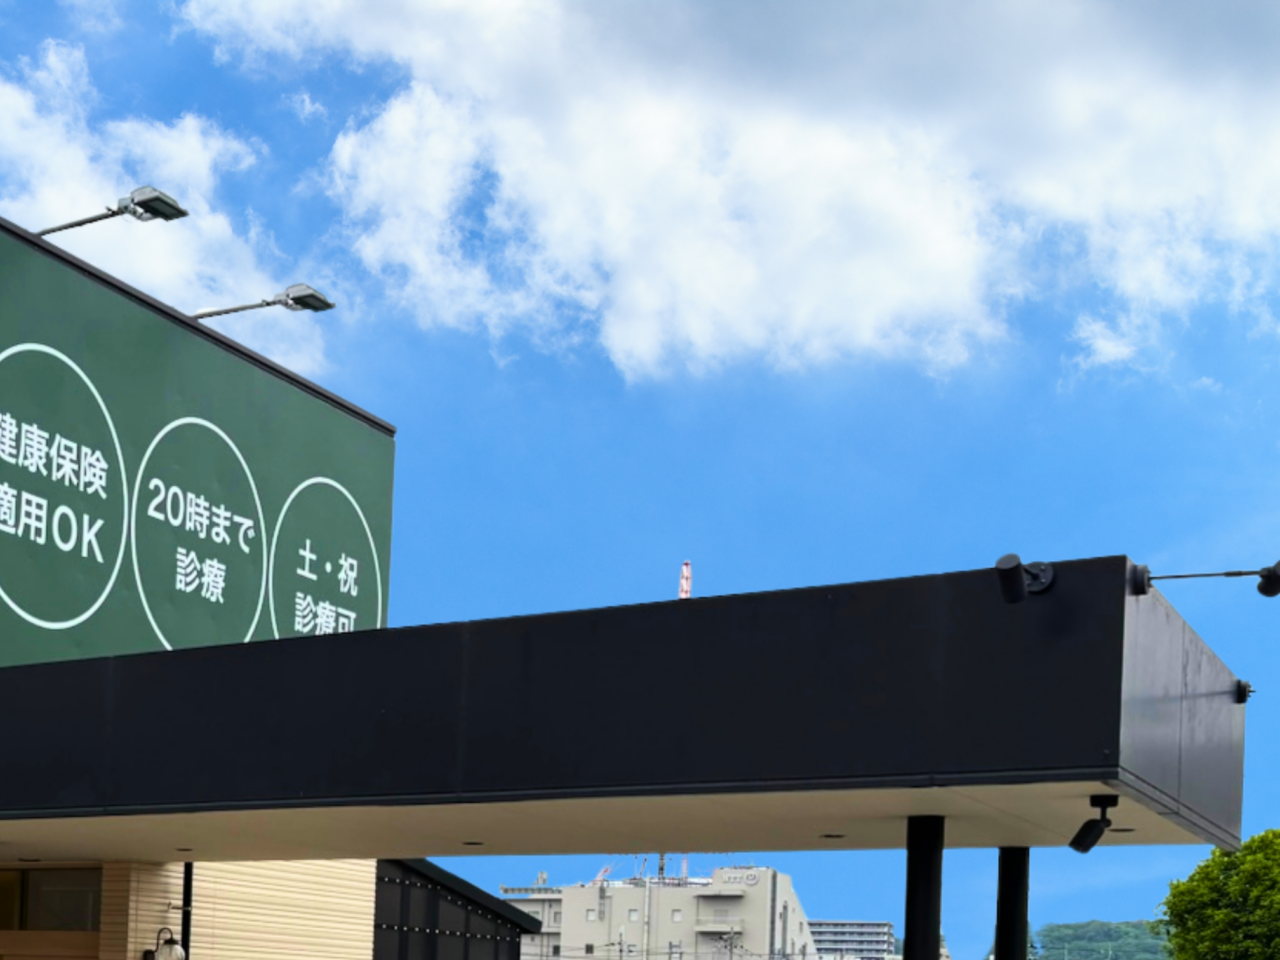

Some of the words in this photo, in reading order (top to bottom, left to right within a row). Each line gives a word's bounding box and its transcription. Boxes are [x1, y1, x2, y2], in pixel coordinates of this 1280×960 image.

[148, 478, 255, 553] 20時まで
[176, 547, 226, 603] 診療
[297, 539, 357, 597] 土・祝
